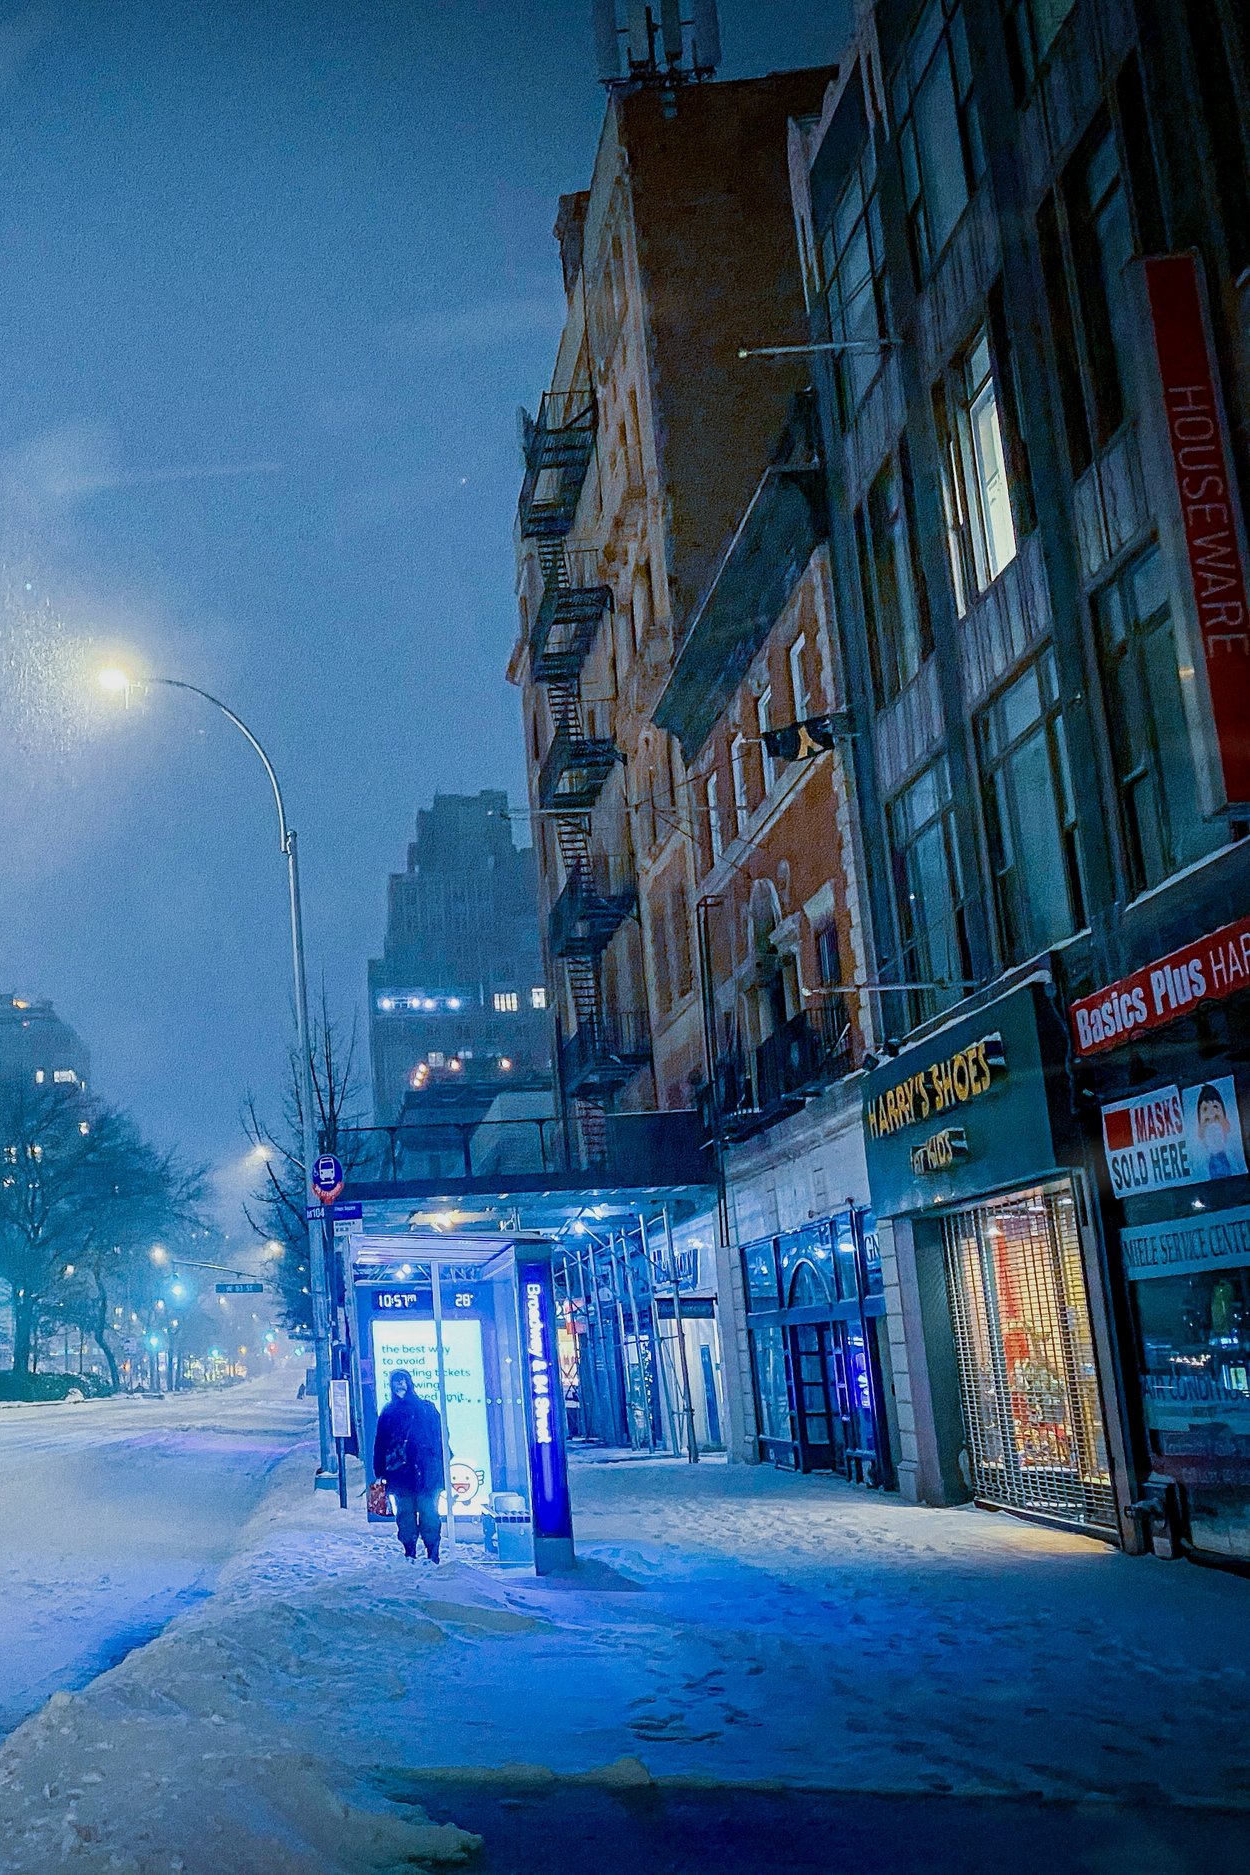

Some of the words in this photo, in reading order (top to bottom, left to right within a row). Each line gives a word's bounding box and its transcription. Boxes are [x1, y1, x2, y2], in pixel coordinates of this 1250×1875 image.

[1168, 385, 1249, 657] HOUSEWARE
[1075, 987, 1147, 1049] Basics
[1150, 958, 1207, 1015] Plus
[868, 1072, 930, 1139] HARRY'S
[931, 1042, 990, 1110] SHOES
[1134, 1096, 1183, 1143] MASKS
[1112, 1152, 1148, 1190] SOLD
[1150, 1140, 1190, 1183] HERE
[1159, 1228, 1208, 1264] SERVICE
[1209, 1219, 1250, 1257] CENTE
[382, 1344, 399, 1353] the
[402, 1344, 425, 1353] best
[429, 1346, 451, 1356] wy
[382, 1357, 394, 1365] to
[396, 1357, 426, 1365] avoid
[383, 1368, 432, 1379] sding
[435, 1368, 471, 1377] tckets
